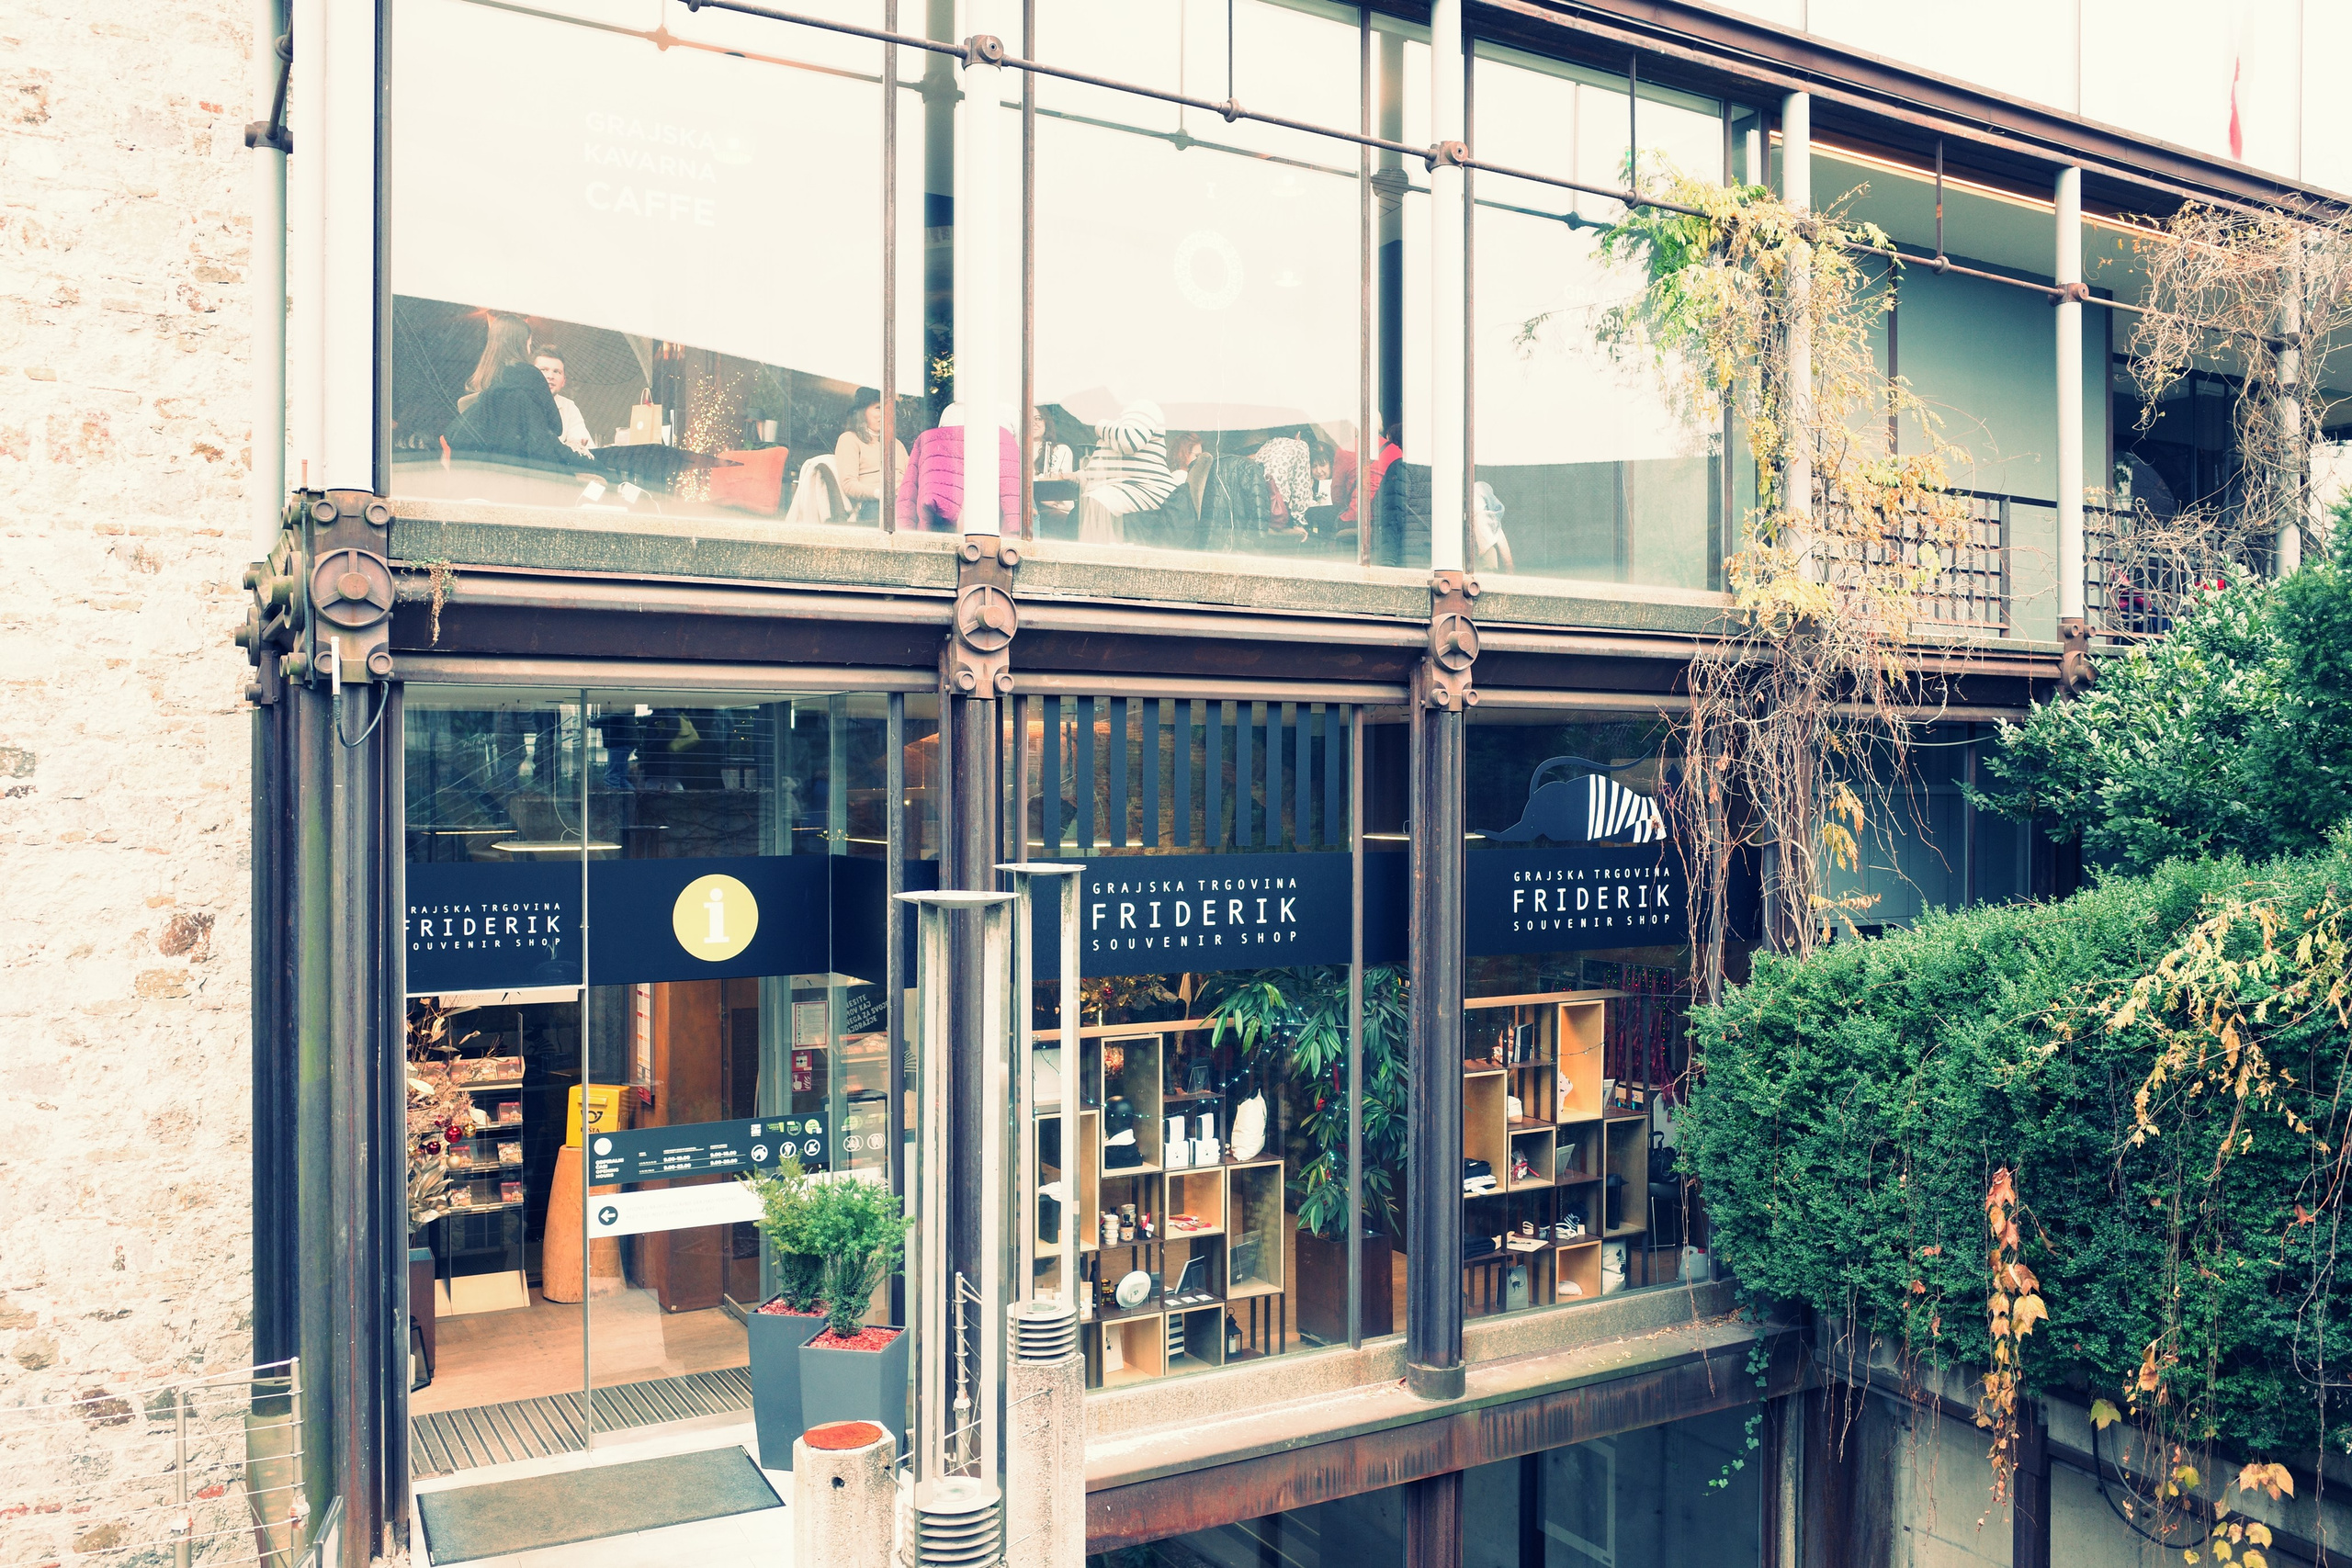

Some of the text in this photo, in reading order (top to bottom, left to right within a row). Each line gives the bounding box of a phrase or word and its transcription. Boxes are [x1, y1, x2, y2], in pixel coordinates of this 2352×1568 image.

[585, 111, 717, 152] GRAJSKA
[584, 141, 717, 185] KAVARNA
[584, 180, 717, 228] CAFFE
[1513, 867, 1670, 882] GRAJSKA TRGOVINA
[1092, 877, 1297, 895] GRAJSKA TRGOVINA
[410, 902, 560, 914] RAJSKA TRGOVINA
[1513, 884, 1670, 914] FRIDERIK
[1092, 897, 1297, 931] FRIDERIK
[1513, 914, 1670, 931] SOUVENIR SHOP
[413, 938, 561, 951] OUVENIR SHOP
[1092, 931, 1297, 952] SOUVENIR SHOP
[846, 993, 867, 1009] NESITE
[846, 1015, 863, 1026] NEGA
[847, 1014, 878, 1034] AJDRAŽJE
